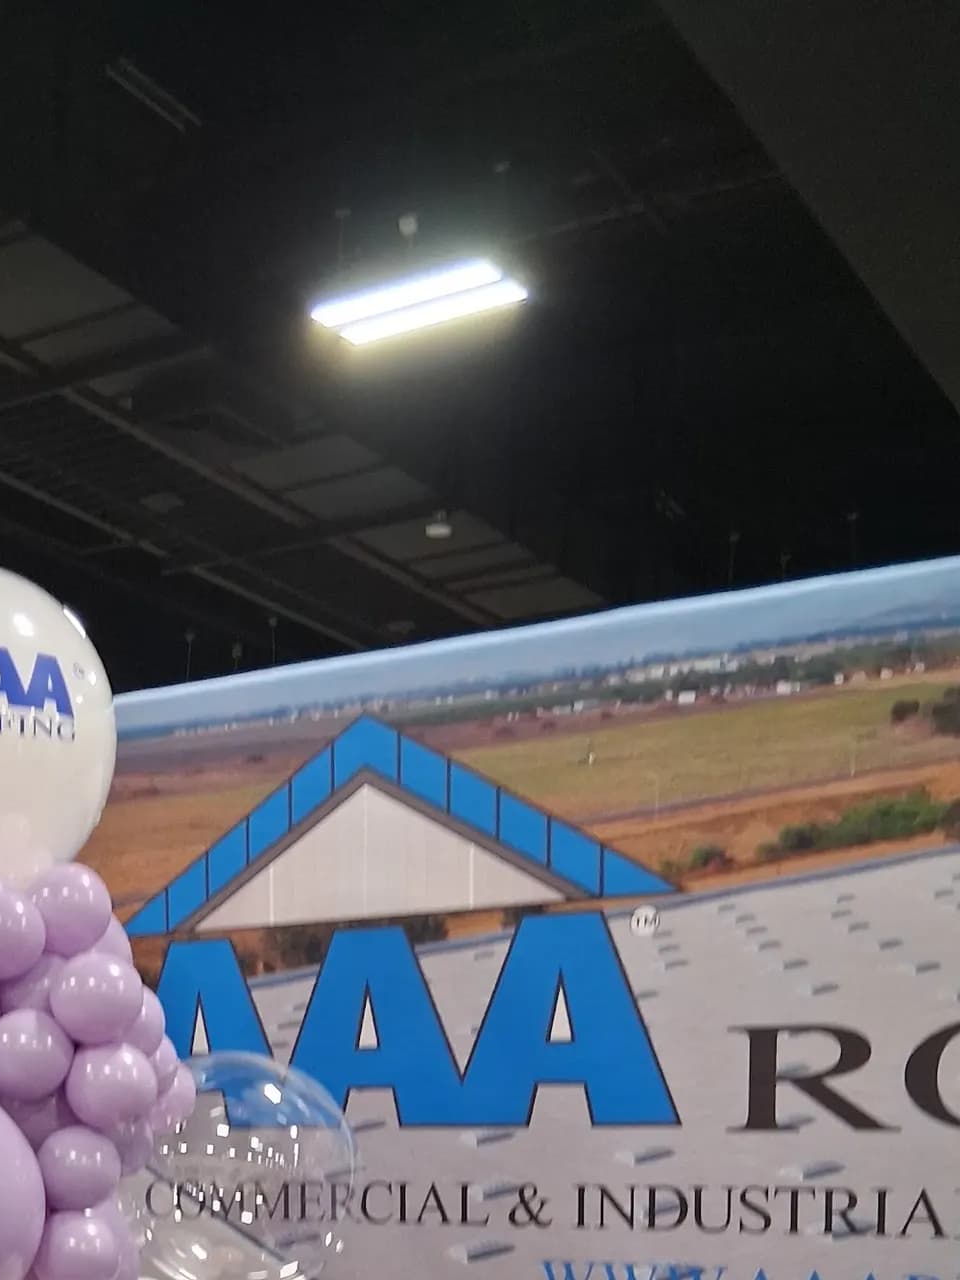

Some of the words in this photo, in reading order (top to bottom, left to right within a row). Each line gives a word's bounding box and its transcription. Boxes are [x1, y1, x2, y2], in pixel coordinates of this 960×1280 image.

[156, 909, 682, 1127] AAA
[145, 1179, 490, 1228] COMMERCIAL
[509, 1182, 553, 1230] &
[576, 1184, 960, 1240] INDUSTRIA
